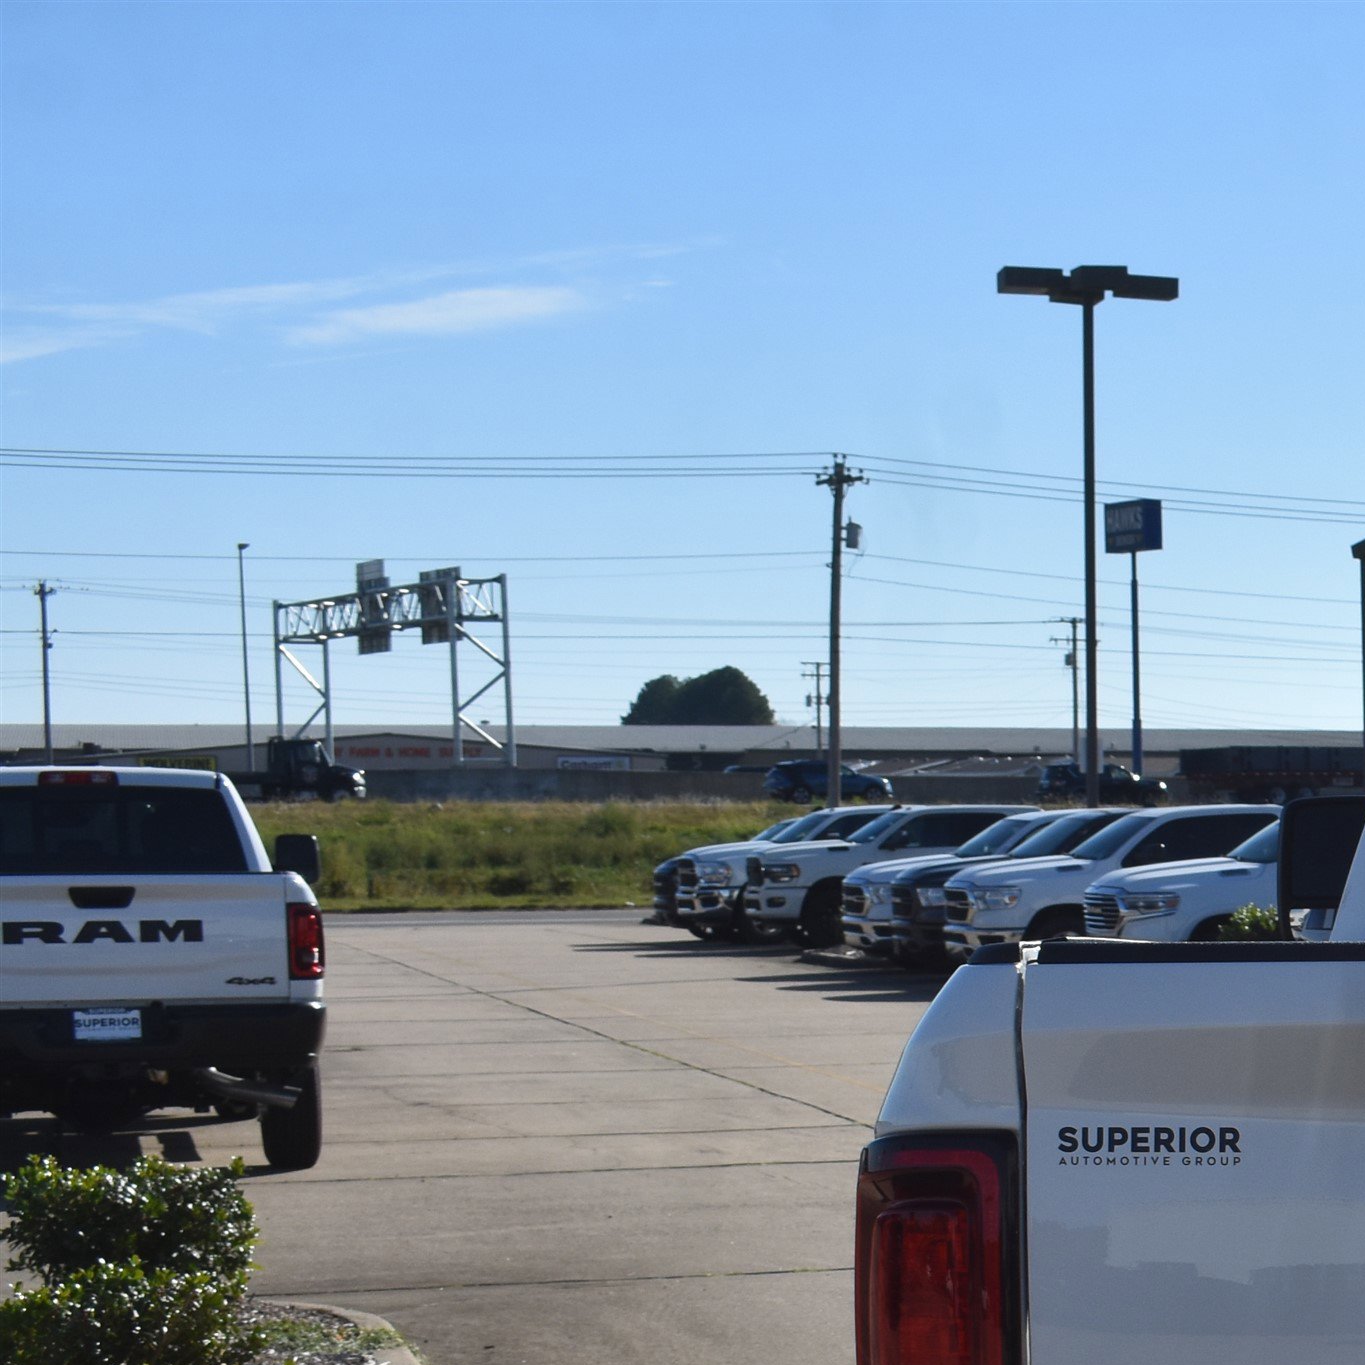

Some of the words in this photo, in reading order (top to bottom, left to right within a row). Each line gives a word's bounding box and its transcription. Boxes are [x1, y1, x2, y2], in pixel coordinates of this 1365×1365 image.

[2, 920, 204, 944] RAM
[74, 1017, 140, 1028] SUPERIOR
[1058, 1126, 1241, 1153] SUPERIOR
[1058, 1156, 1171, 1166] AUTOMOTIVE
[1181, 1156, 1242, 1166] GROUP
